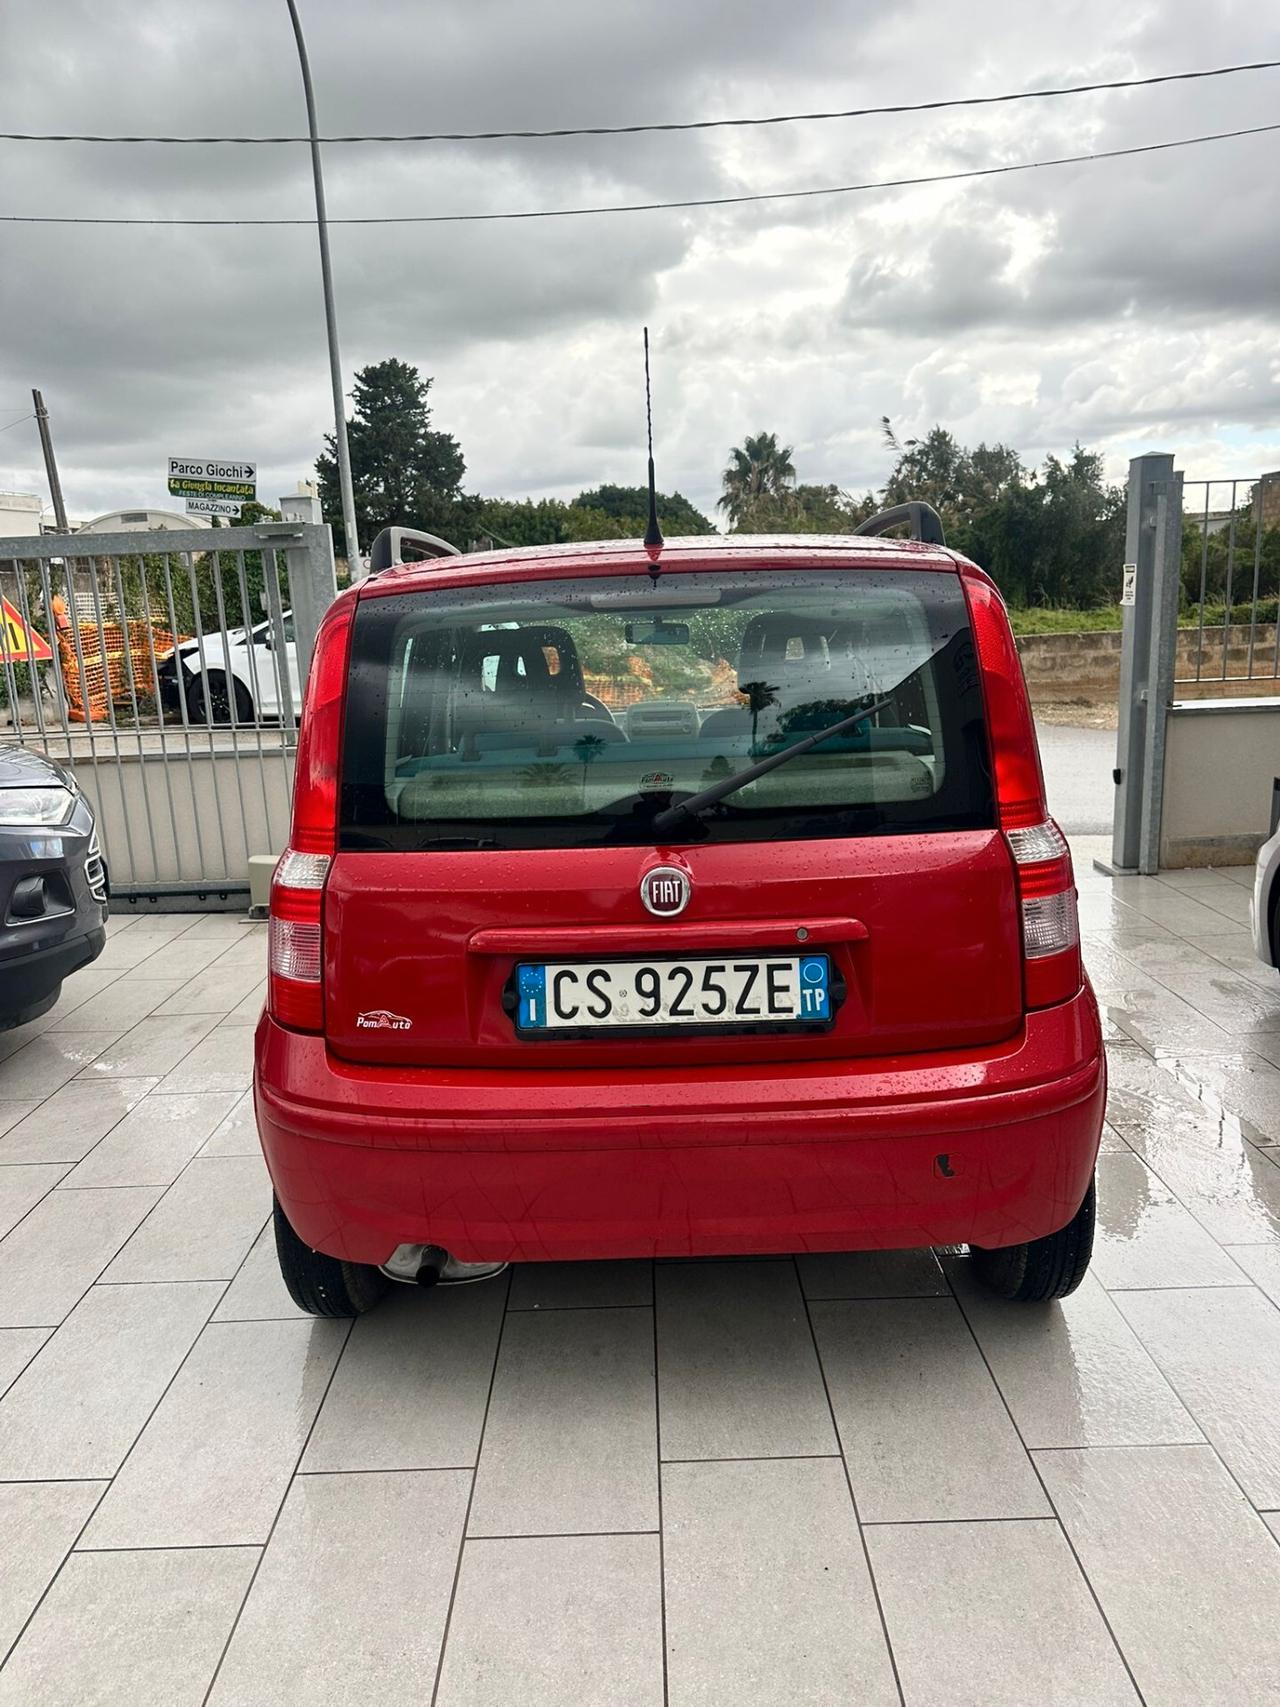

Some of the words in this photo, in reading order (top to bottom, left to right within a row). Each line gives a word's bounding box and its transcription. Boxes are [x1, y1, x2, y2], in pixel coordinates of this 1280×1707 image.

[171, 461, 203, 475] Parco
[206, 464, 243, 478] Giochi
[188, 502, 231, 513] MAGAZZINO
[652, 880, 681, 903] FIAT
[529, 998, 536, 1021] I
[553, 968, 612, 1020] CS
[634, 963, 794, 1018] 925ZE
[802, 988, 826, 1012] TP
